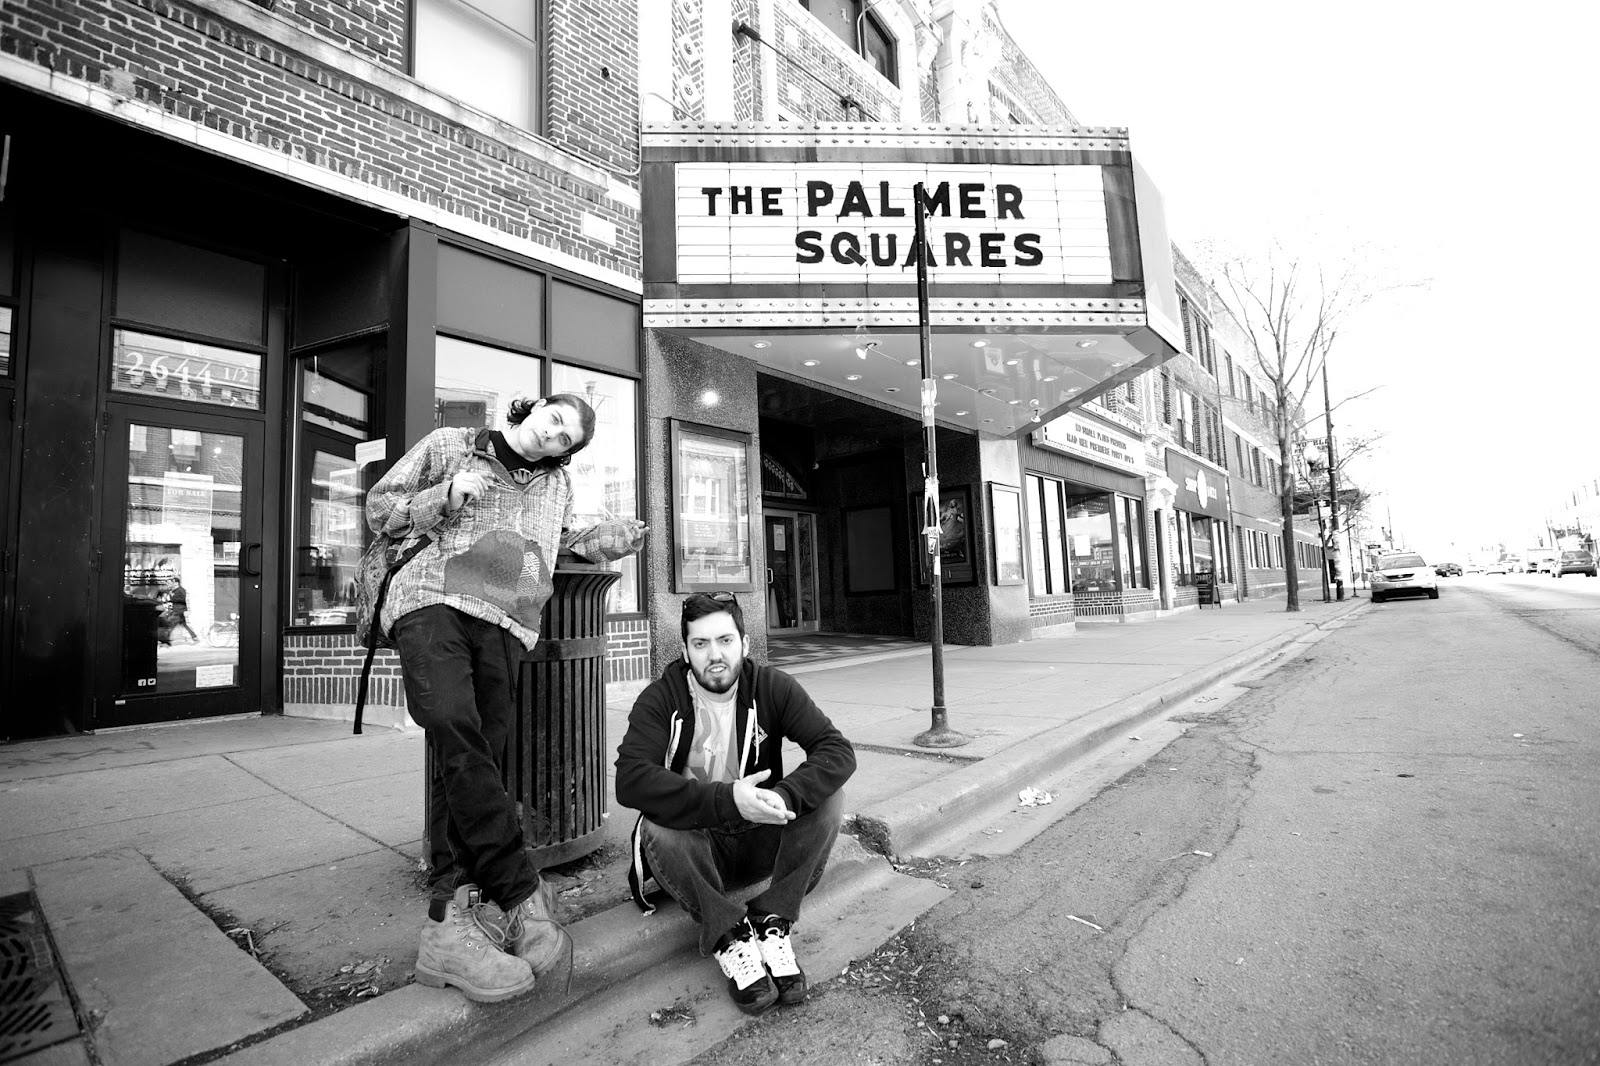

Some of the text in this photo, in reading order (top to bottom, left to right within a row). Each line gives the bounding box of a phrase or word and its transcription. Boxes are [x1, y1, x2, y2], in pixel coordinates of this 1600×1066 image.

[702, 181, 1025, 219] THE PALMER
[796, 230, 1043, 267] SQUARES
[125, 352, 249, 387] 2644 1/2
